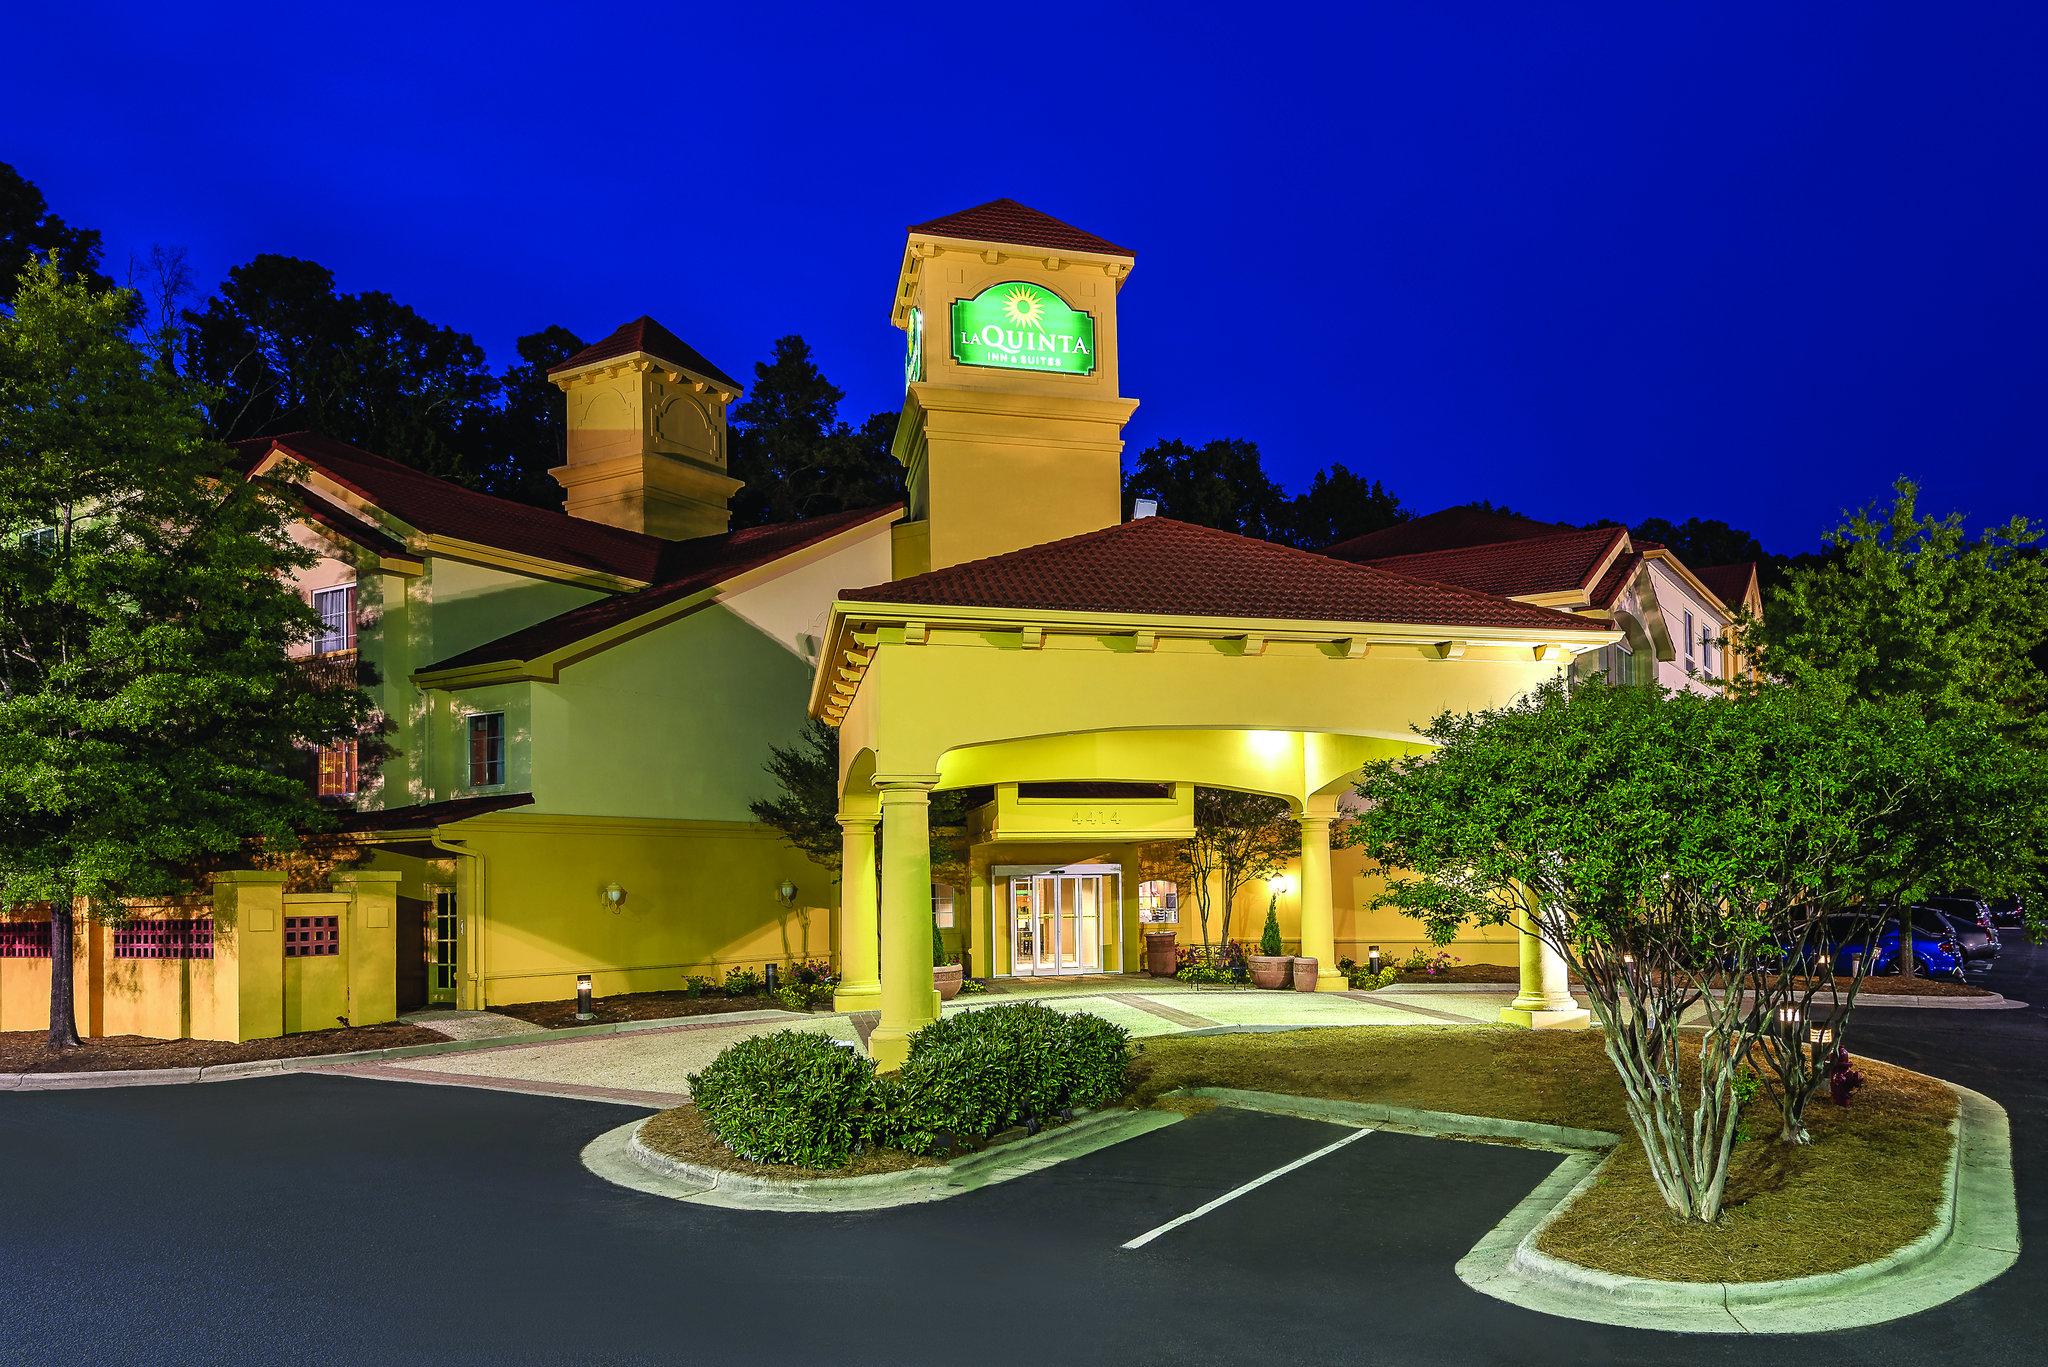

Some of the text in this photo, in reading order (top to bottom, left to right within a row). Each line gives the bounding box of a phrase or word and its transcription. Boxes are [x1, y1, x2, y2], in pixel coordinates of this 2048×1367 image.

[961, 324, 1088, 354] LA QUINTA
[987, 351, 1062, 367] INN & SUITES
[1072, 808, 1121, 825] 4414
